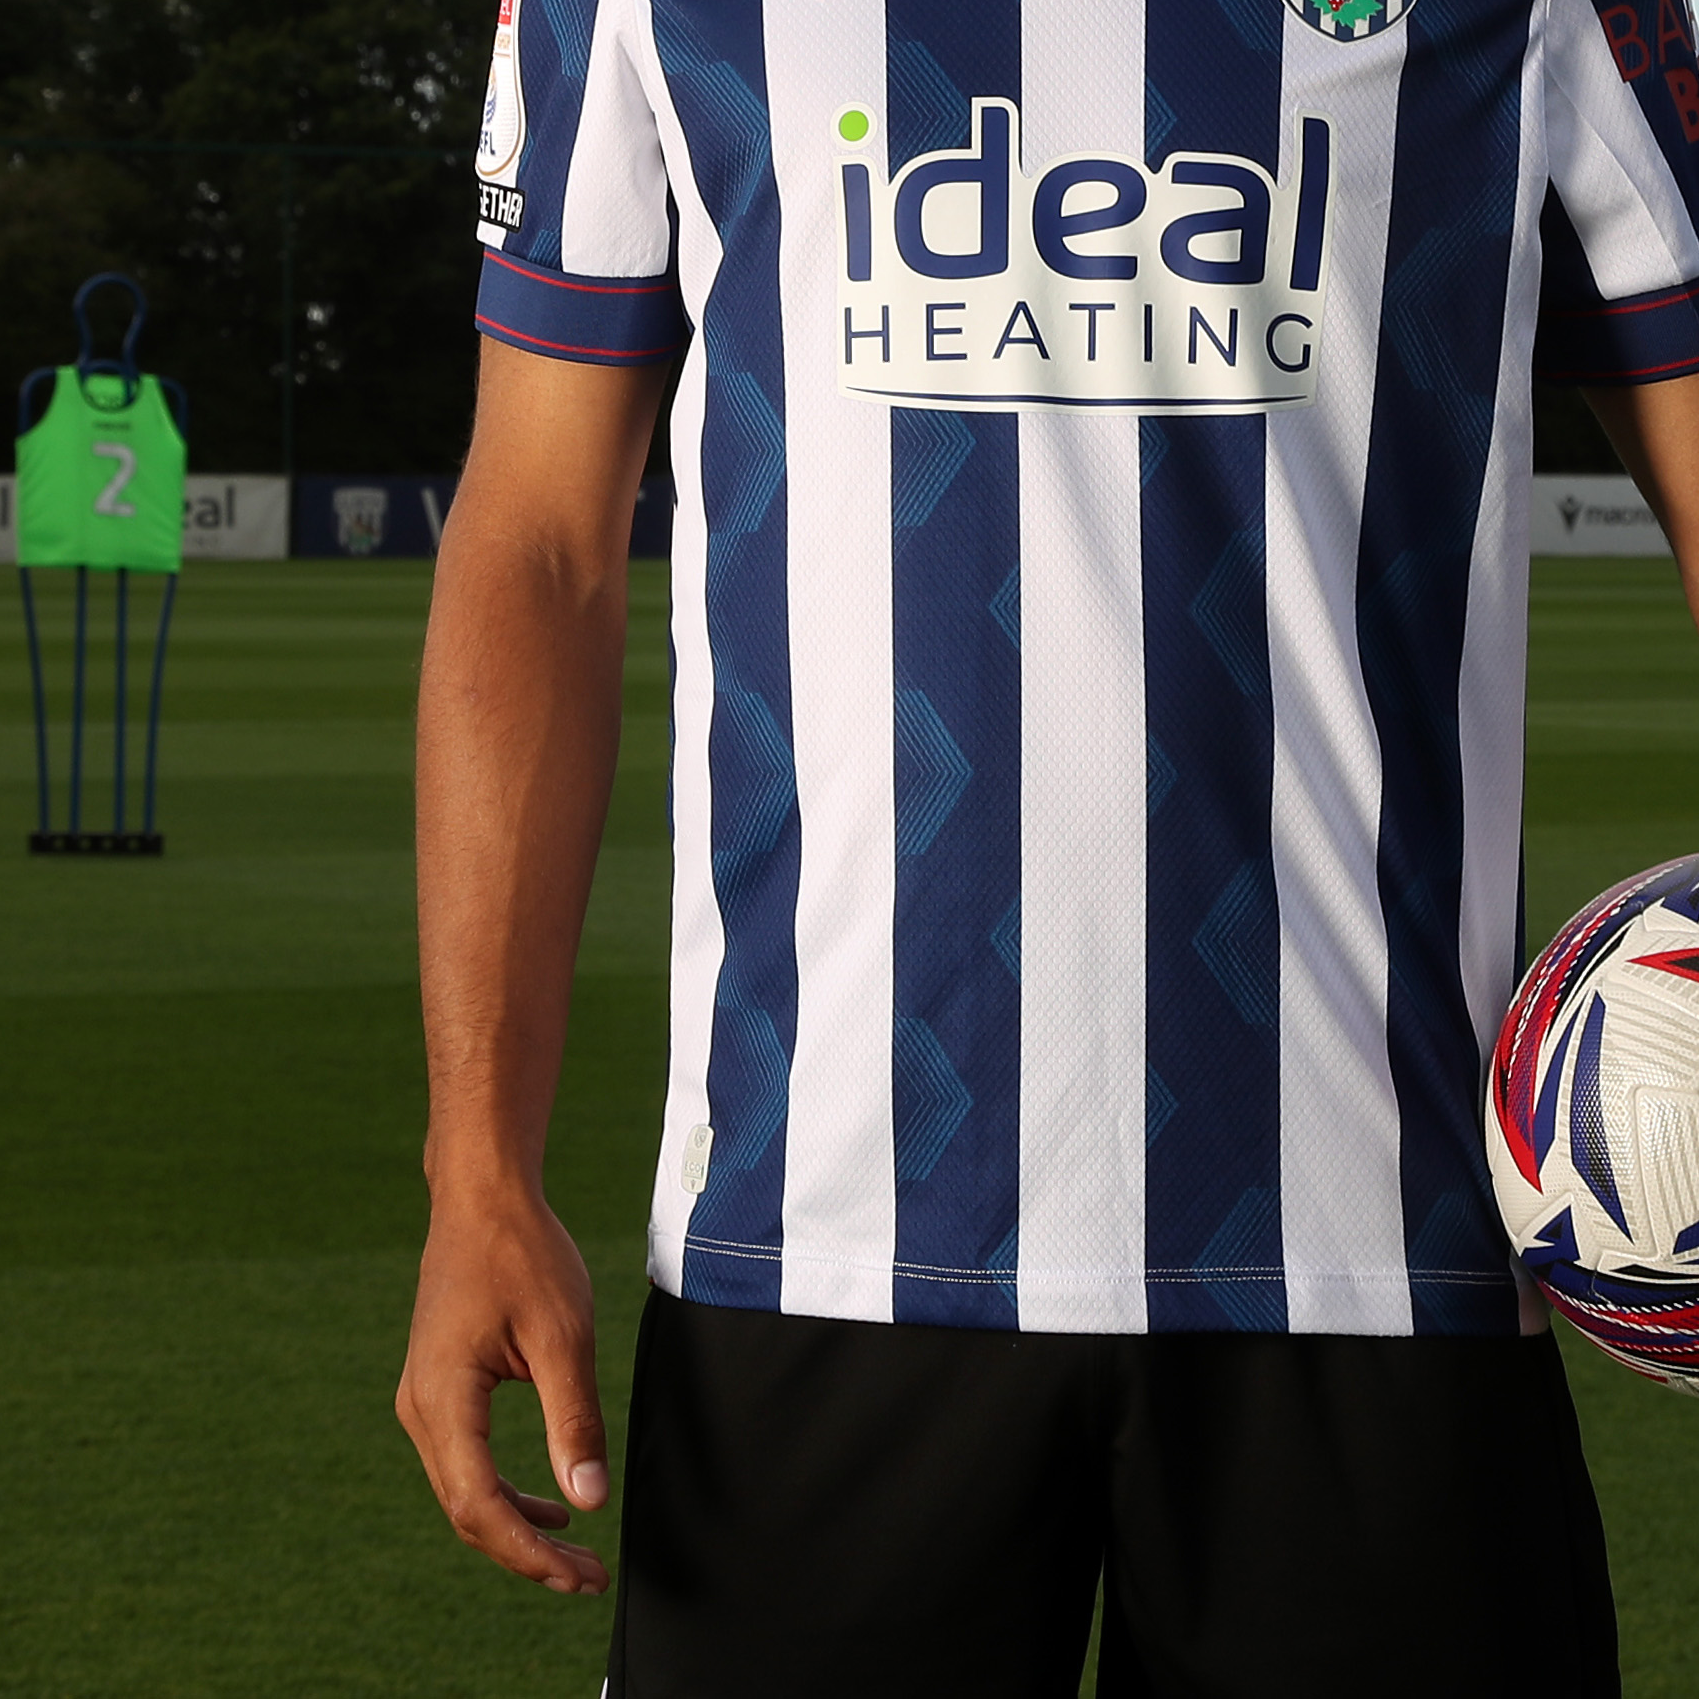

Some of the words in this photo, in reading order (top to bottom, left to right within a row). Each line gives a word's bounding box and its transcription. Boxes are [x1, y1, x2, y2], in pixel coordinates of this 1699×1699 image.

[838, 105, 1330, 292] ideal
[844, 300, 1313, 373] HEATING
[91, 440, 137, 518] 2
